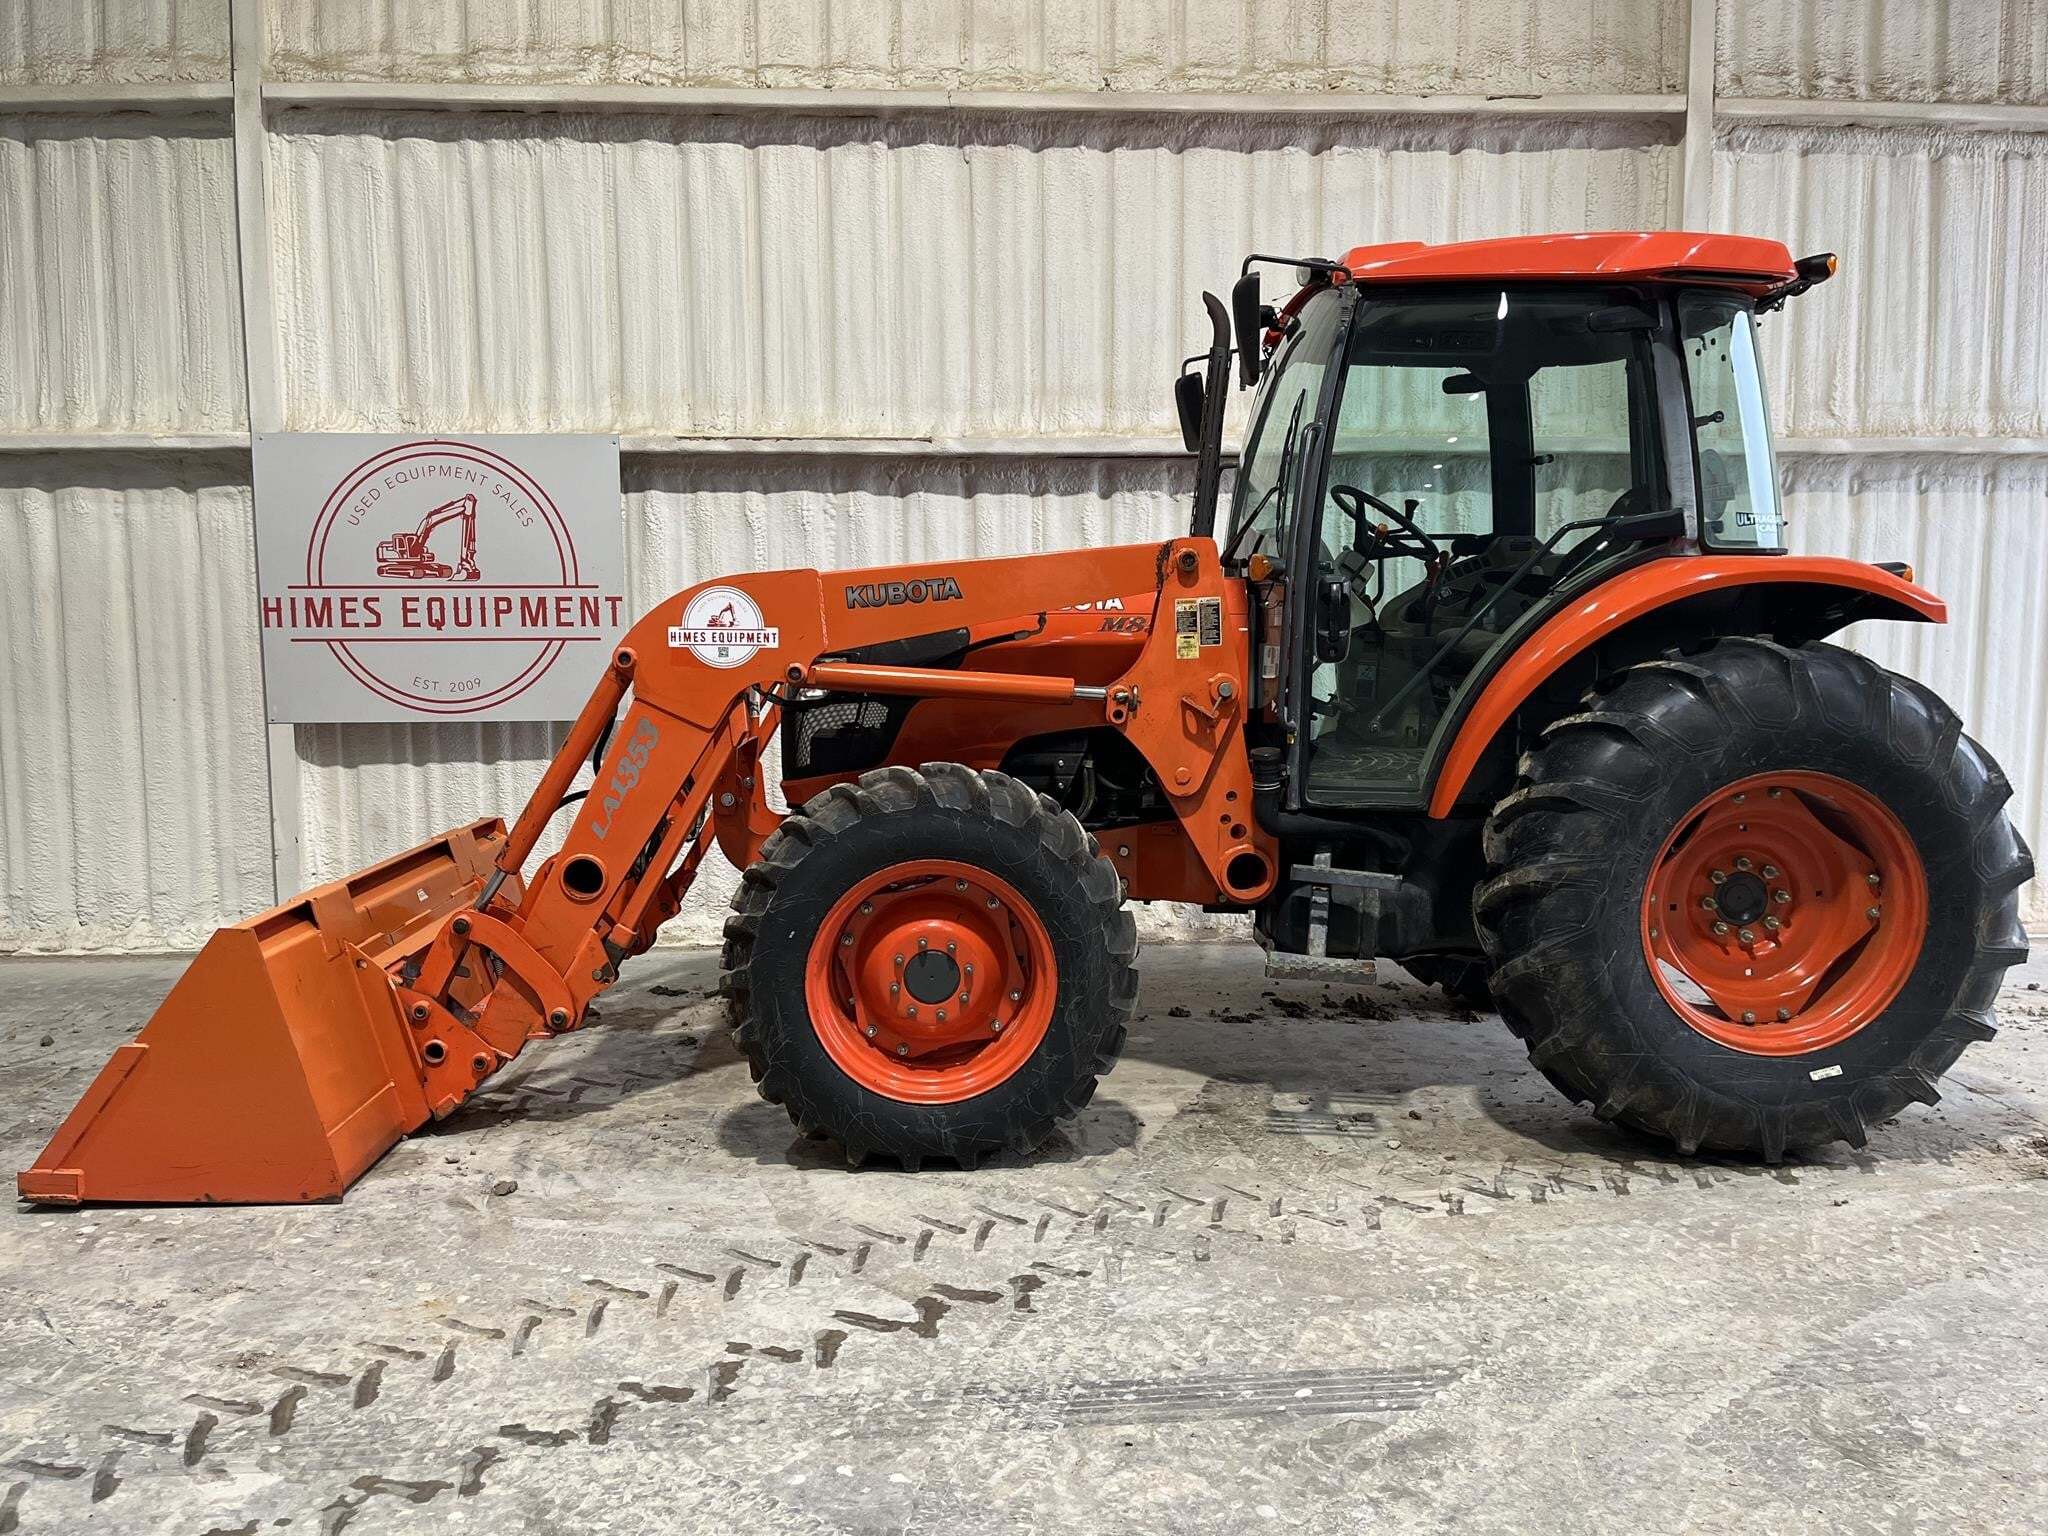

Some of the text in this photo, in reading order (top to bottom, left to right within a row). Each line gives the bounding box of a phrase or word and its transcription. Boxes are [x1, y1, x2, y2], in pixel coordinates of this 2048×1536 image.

[347, 465, 534, 528] USED EQUIPMENT SALES
[845, 577, 963, 609] KUBOTA
[263, 596, 623, 631] HIMES EQUIPMENT
[670, 631, 777, 644] HIMES EQUIPMENT
[413, 676, 482, 693] EST. 2009
[591, 715, 660, 840] LA1353
